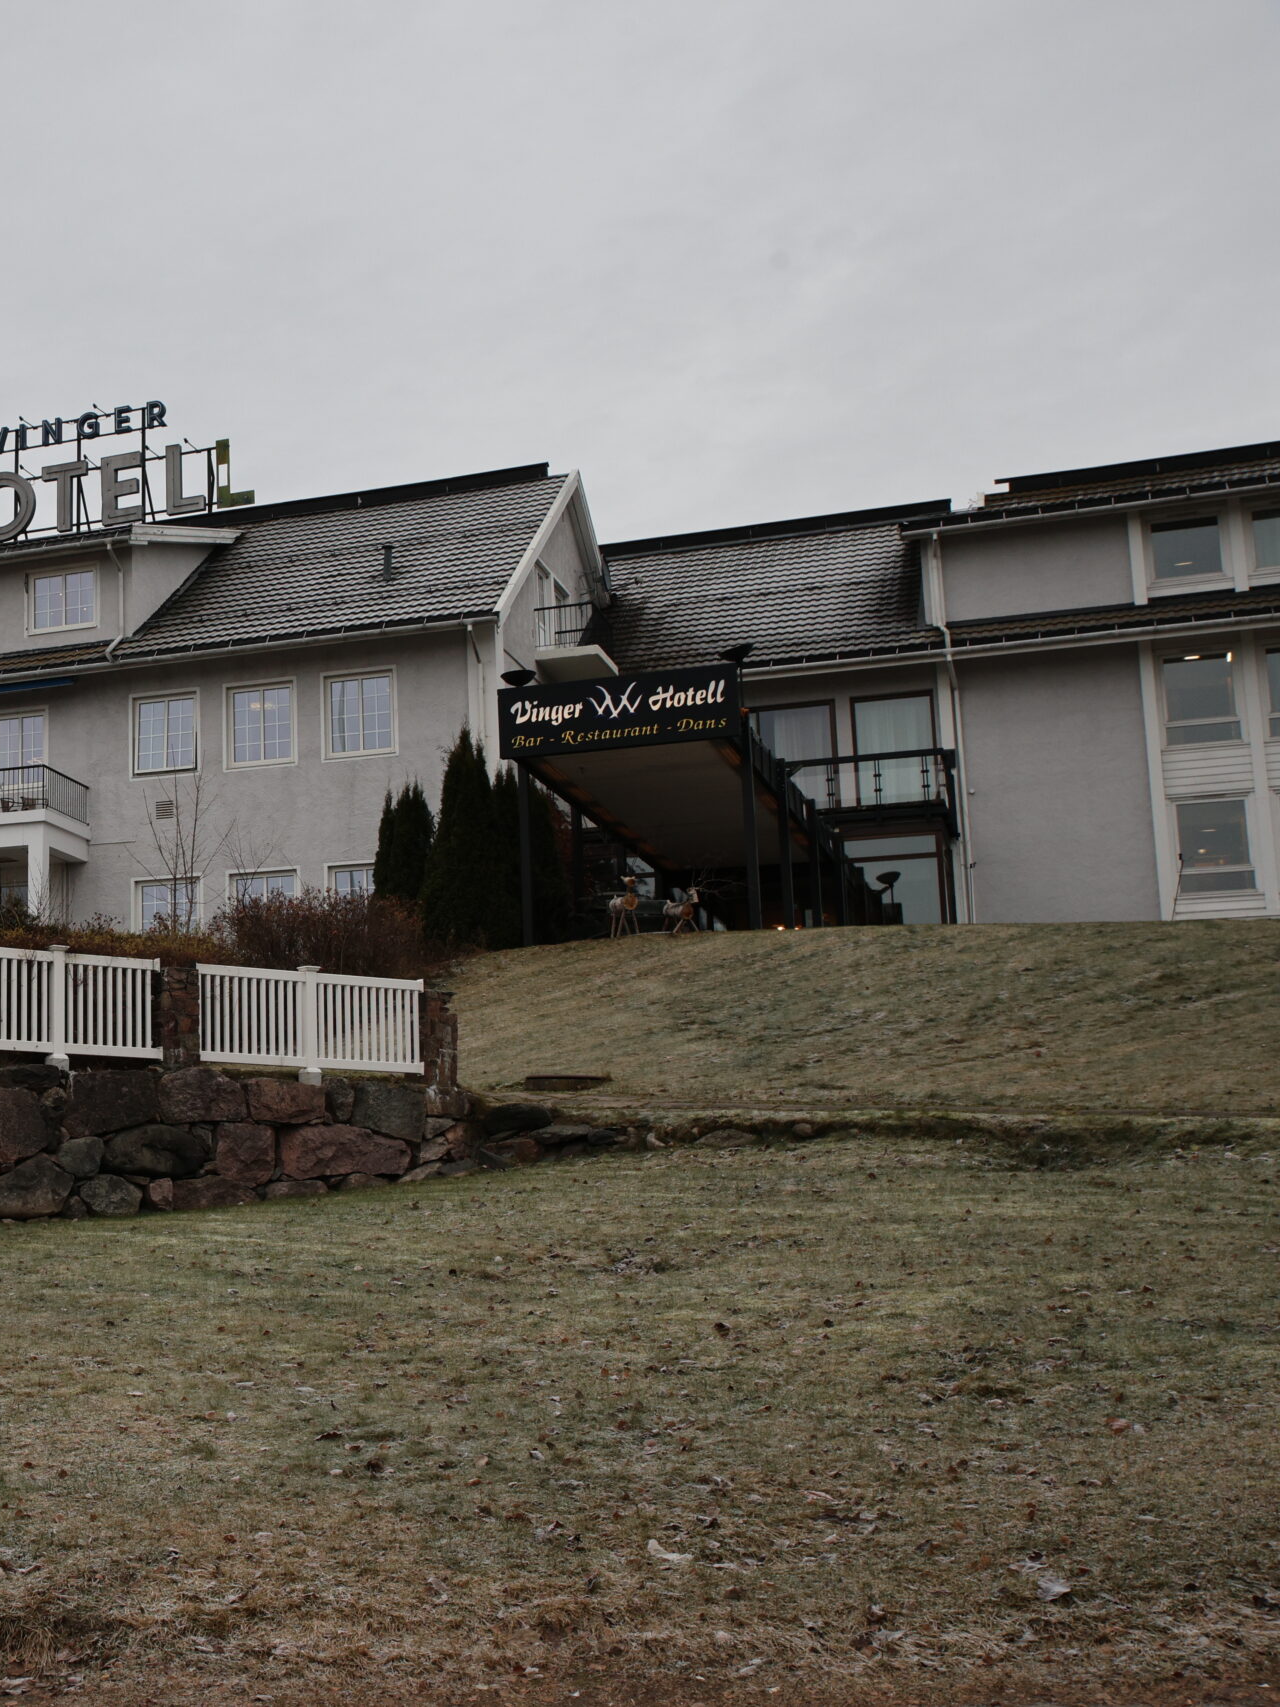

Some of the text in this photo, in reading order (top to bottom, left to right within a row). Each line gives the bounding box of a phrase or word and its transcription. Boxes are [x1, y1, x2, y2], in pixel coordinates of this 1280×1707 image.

[510, 700, 583, 726] Vinger
[648, 679, 726, 711] Hotell
[511, 735, 544, 750] Bar
[561, 722, 660, 746] Restaurant
[677, 717, 727, 733] Dans
